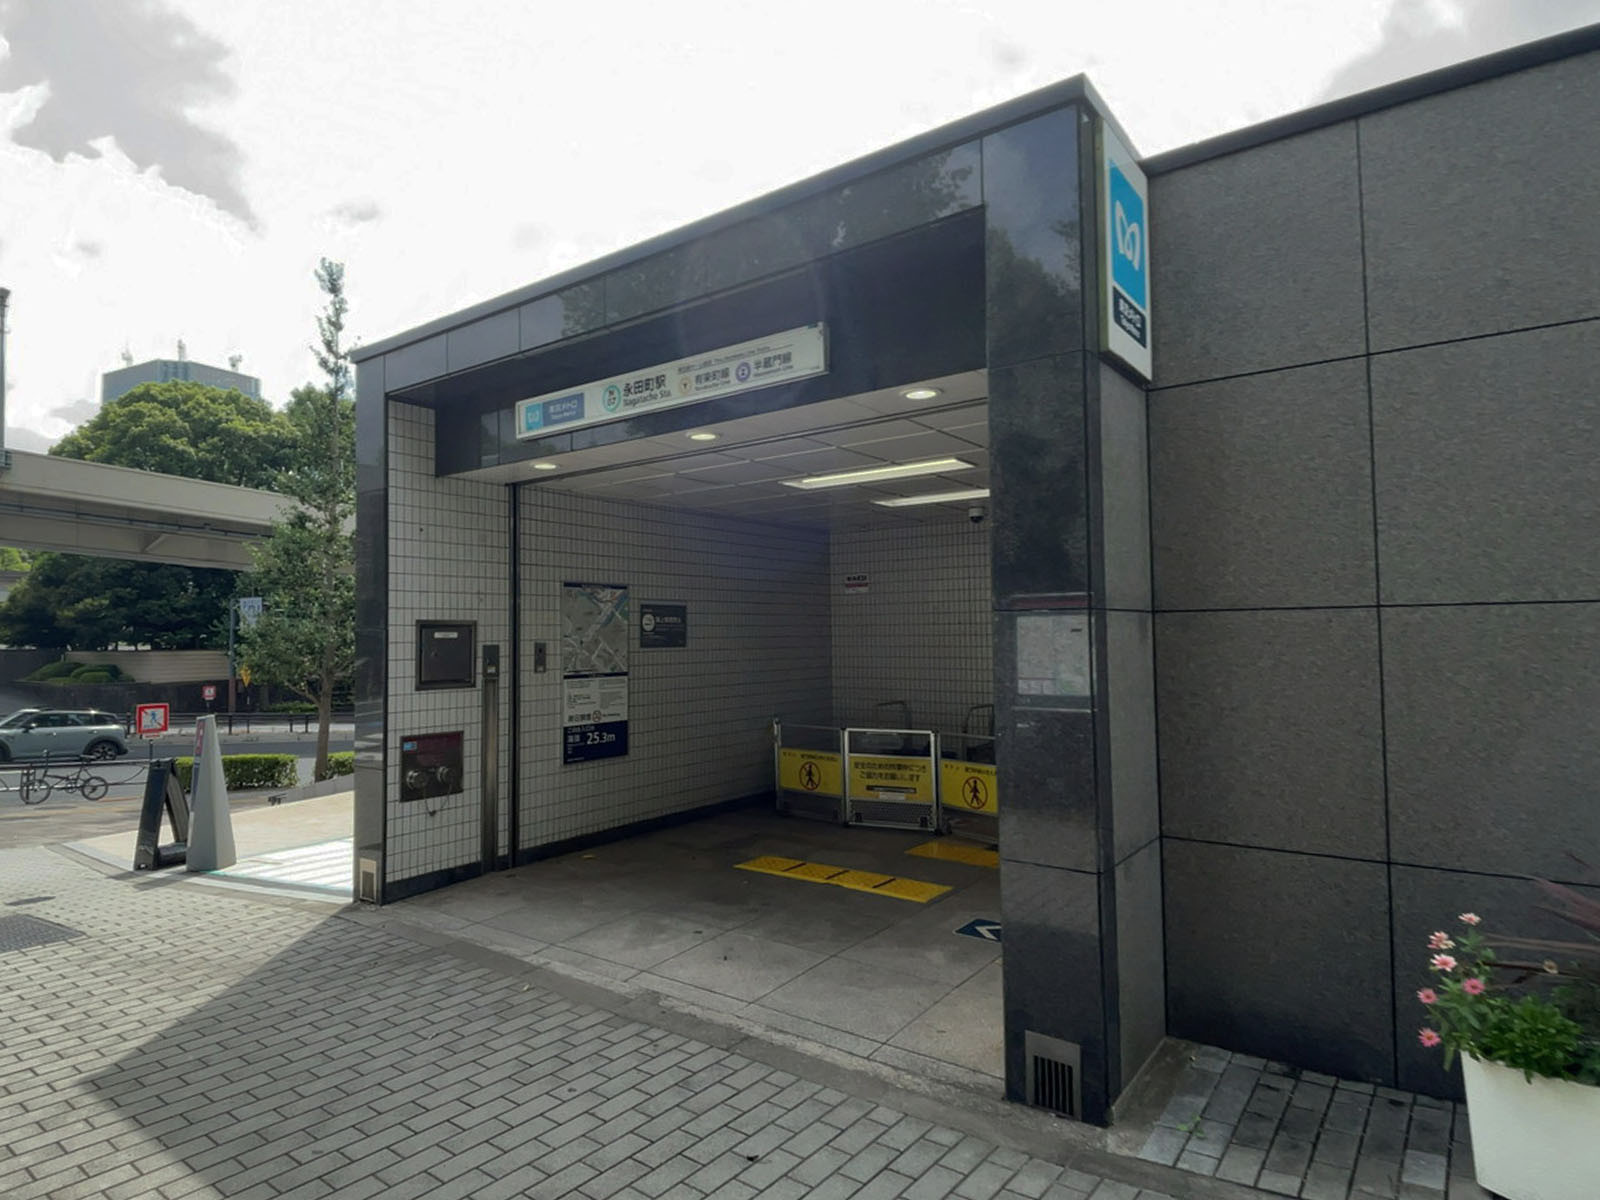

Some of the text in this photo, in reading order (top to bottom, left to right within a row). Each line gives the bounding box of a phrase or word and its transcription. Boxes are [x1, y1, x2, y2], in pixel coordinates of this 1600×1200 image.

[624, 375, 666, 397] 永田町駅
[586, 731, 616, 745] 25.3m
